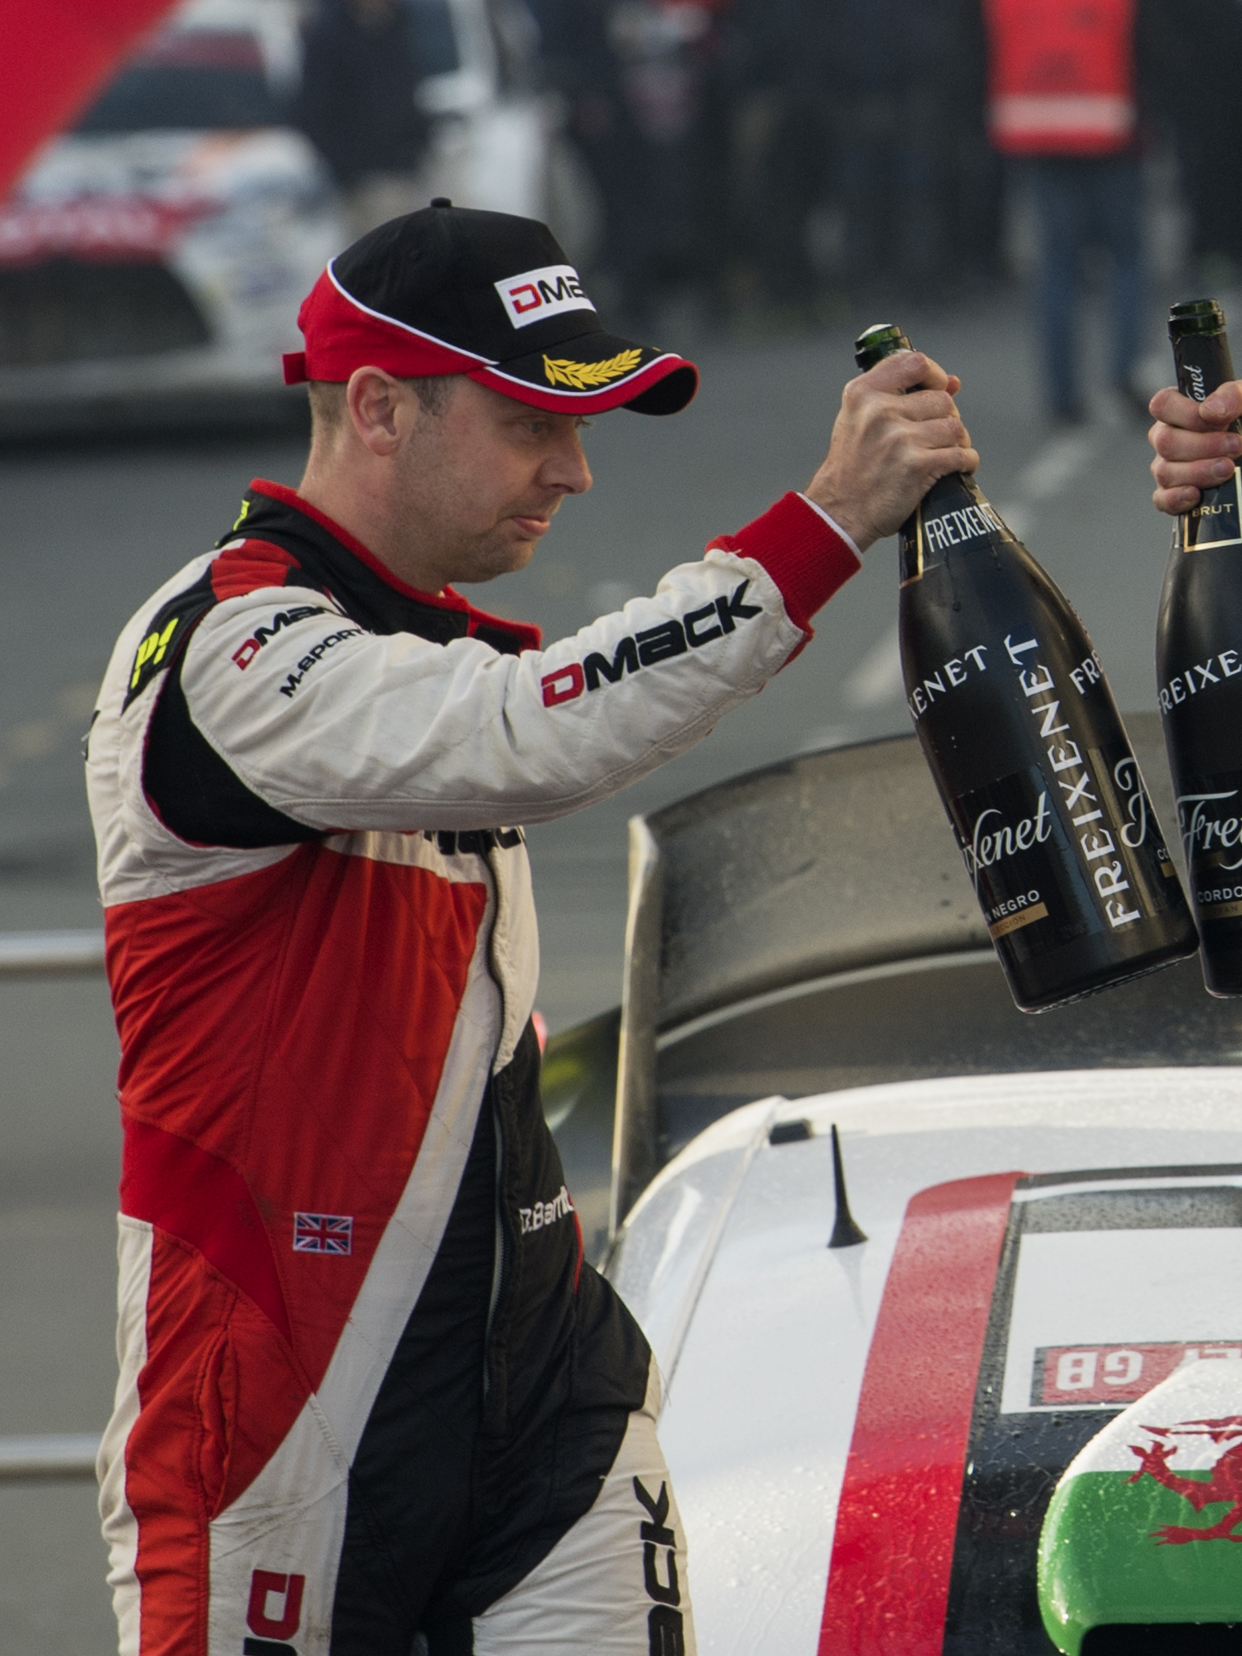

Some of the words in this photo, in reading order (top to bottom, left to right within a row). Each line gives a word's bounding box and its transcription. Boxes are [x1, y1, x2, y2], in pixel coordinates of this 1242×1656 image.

[1184, 364, 1206, 401] enet
[1191, 502, 1234, 518] BRUT
[1004, 634, 1141, 928] FREIXENET
[992, 889, 1040, 919] NEGRO
[1056, 1350, 1144, 1391] GB
